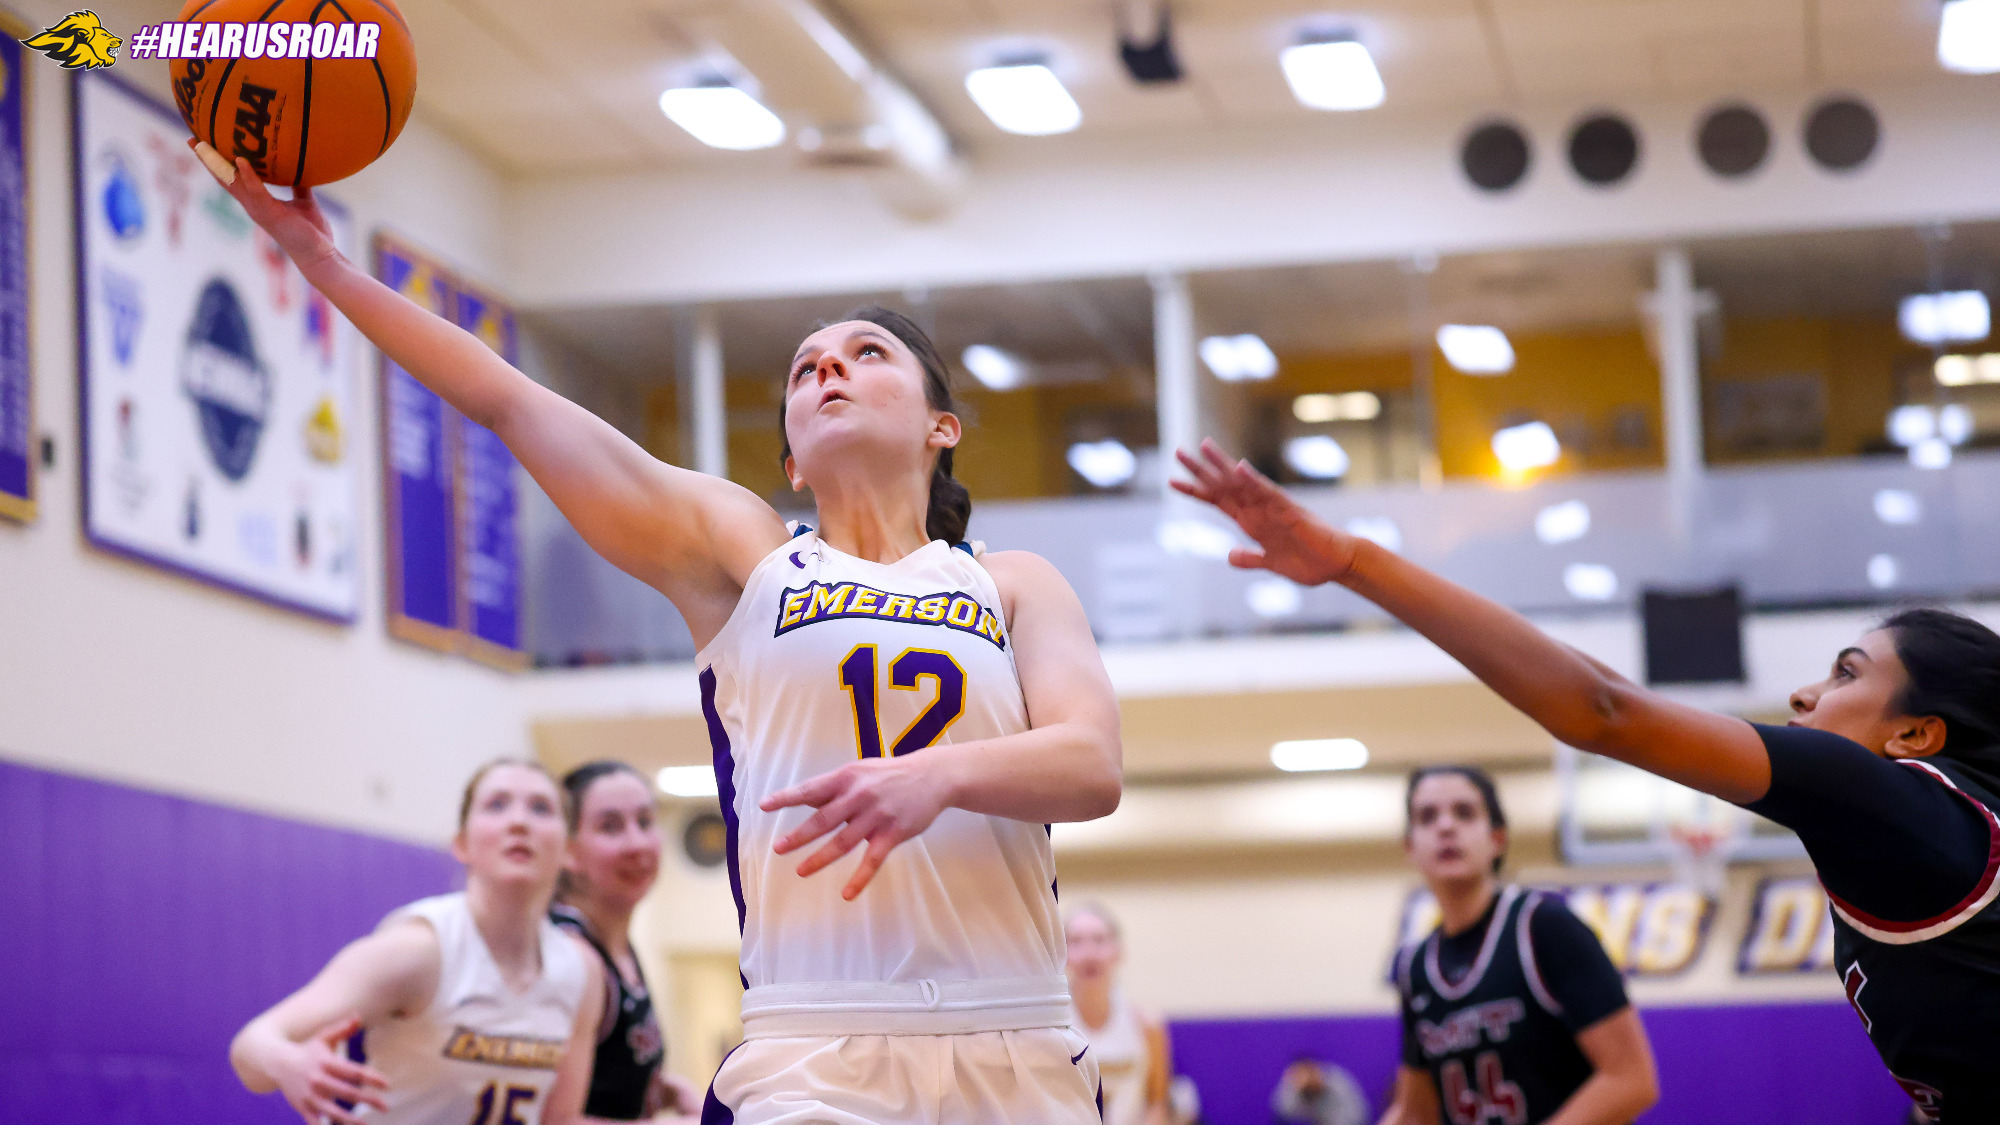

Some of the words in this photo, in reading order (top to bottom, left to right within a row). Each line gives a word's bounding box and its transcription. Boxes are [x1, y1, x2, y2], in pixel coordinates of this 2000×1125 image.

[775, 580, 1005, 652] EMERSON
[838, 643, 967, 759] 12
[1735, 878, 1835, 973] D
